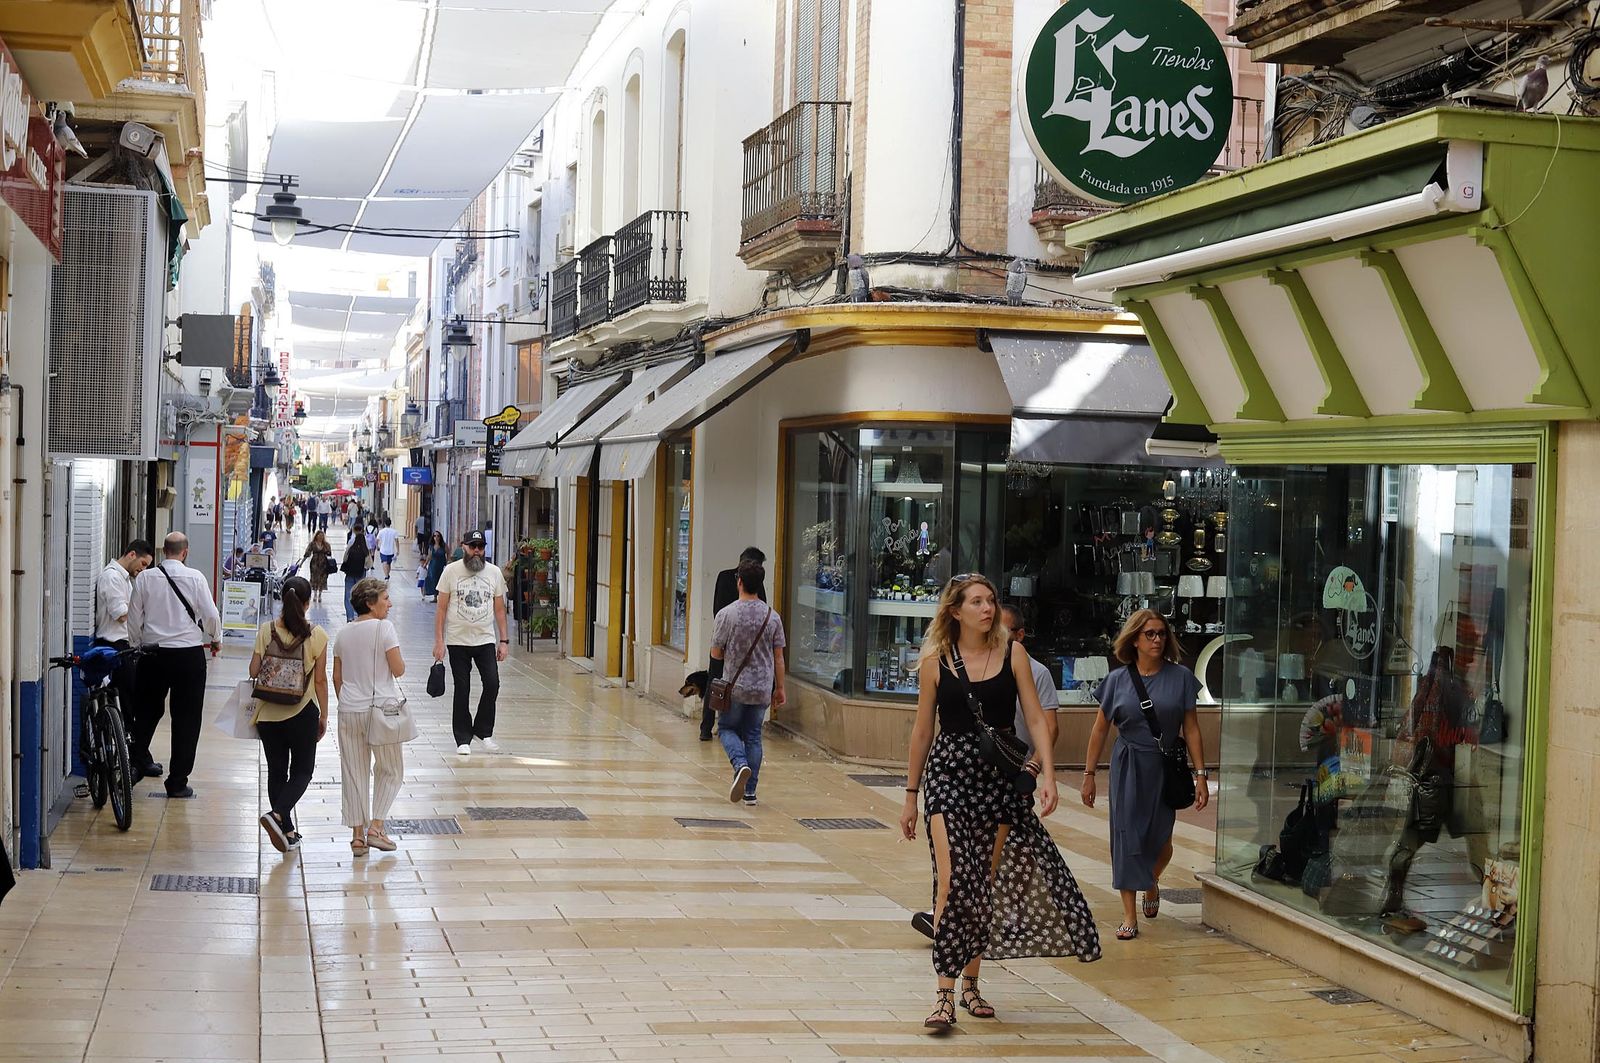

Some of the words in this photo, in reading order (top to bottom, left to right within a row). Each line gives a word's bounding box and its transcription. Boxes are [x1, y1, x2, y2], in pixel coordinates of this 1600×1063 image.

[1152, 46, 1214, 71] Tiendas
[1080, 168, 1130, 194] Fundada
[1133, 185, 1148, 195] en
[1150, 174, 1174, 192] 1915
[278, 351, 290, 419] RESTAURANTE
